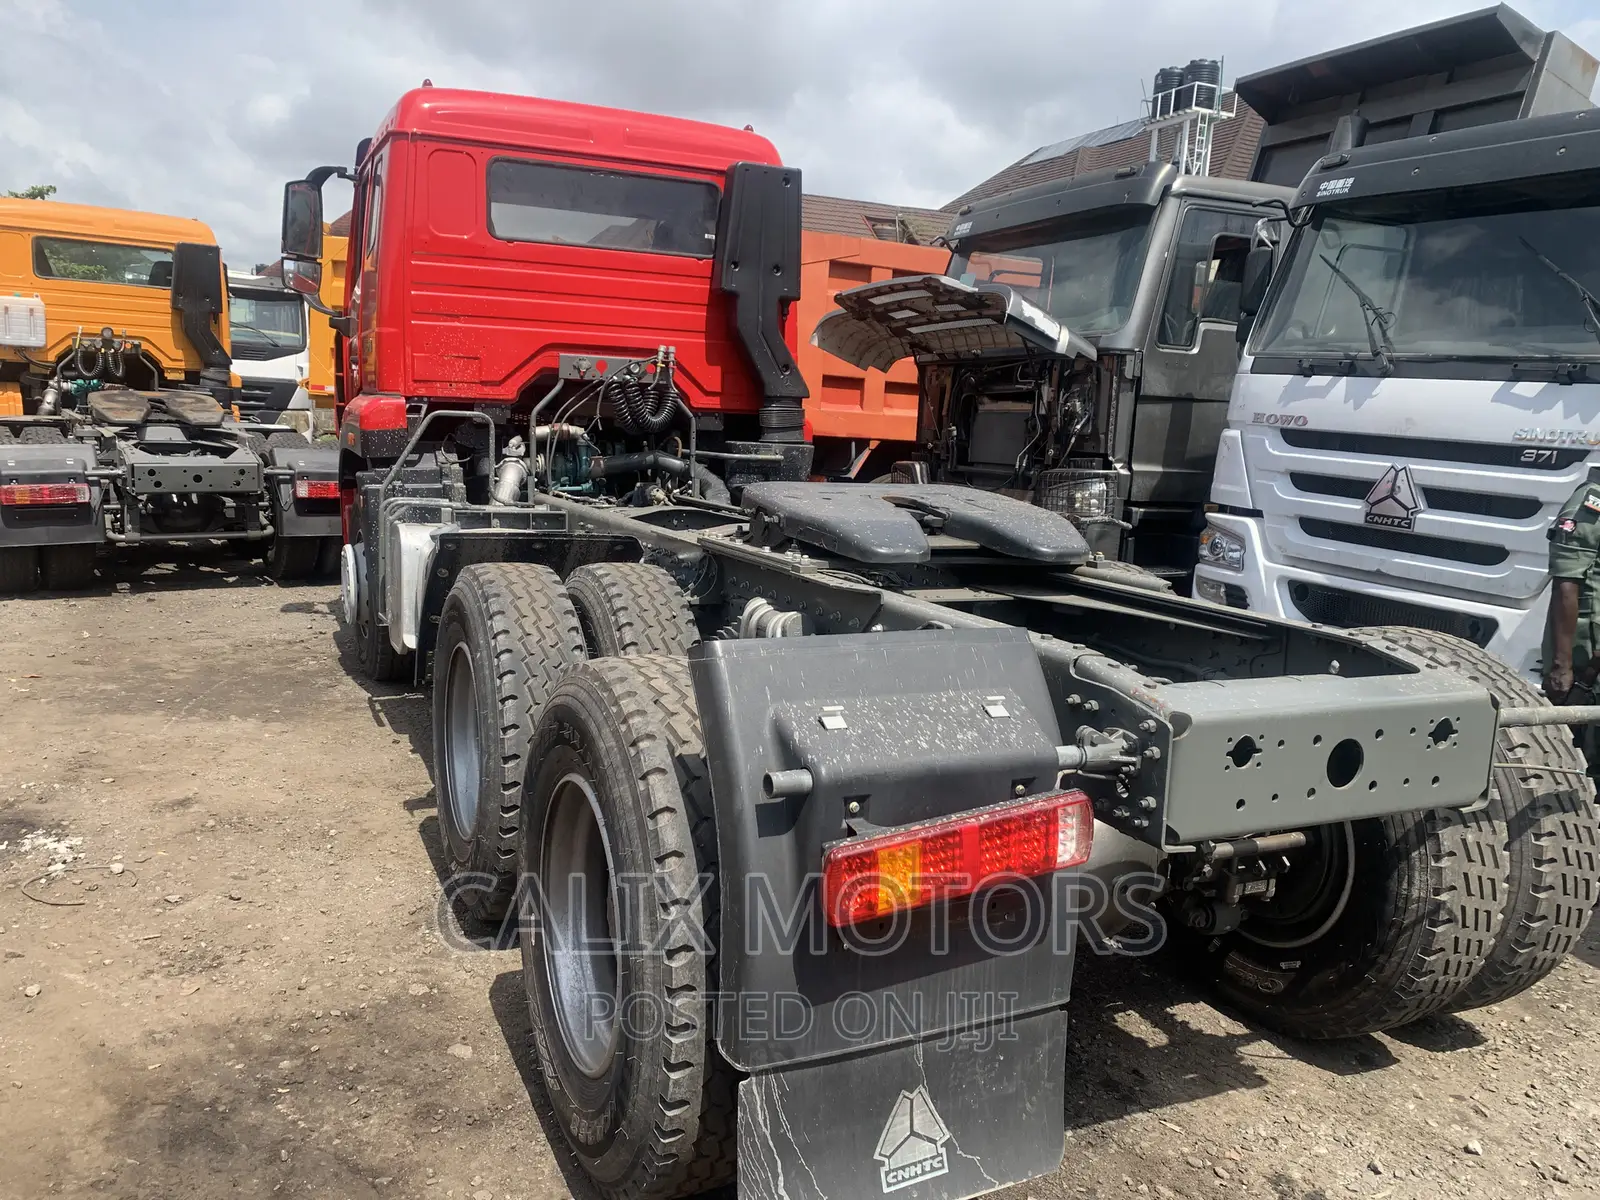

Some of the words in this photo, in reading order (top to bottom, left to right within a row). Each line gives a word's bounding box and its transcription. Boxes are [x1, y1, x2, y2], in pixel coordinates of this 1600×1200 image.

[1316, 187, 1350, 197] SINOTRUK
[1252, 412, 1308, 426] HOWO
[1520, 449, 1558, 464] 371
[1366, 515, 1411, 527] CNHTC
[886, 1156, 943, 1183] CNHTC
